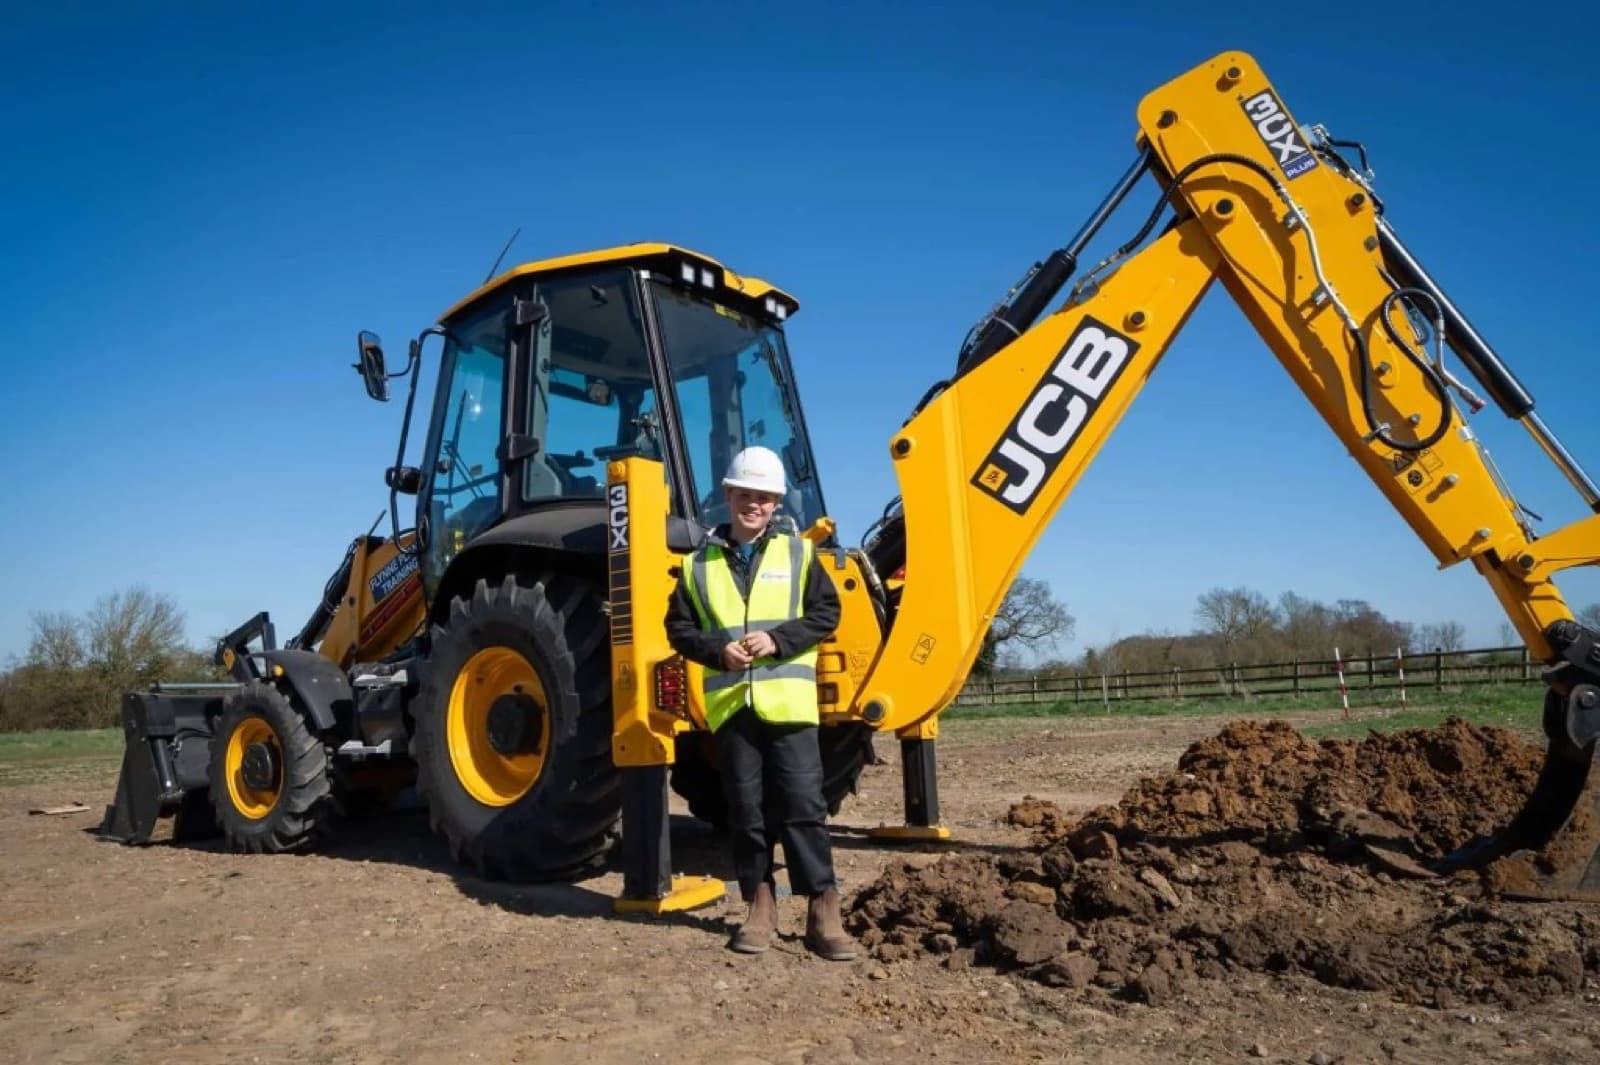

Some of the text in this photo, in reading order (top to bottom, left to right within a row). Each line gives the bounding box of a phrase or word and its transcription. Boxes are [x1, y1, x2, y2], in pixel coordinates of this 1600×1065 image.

[1245, 93, 1306, 163] 3CX
[1286, 160, 1316, 178] PLUS
[998, 327, 1128, 504] JCB
[610, 485, 628, 548] 3CX
